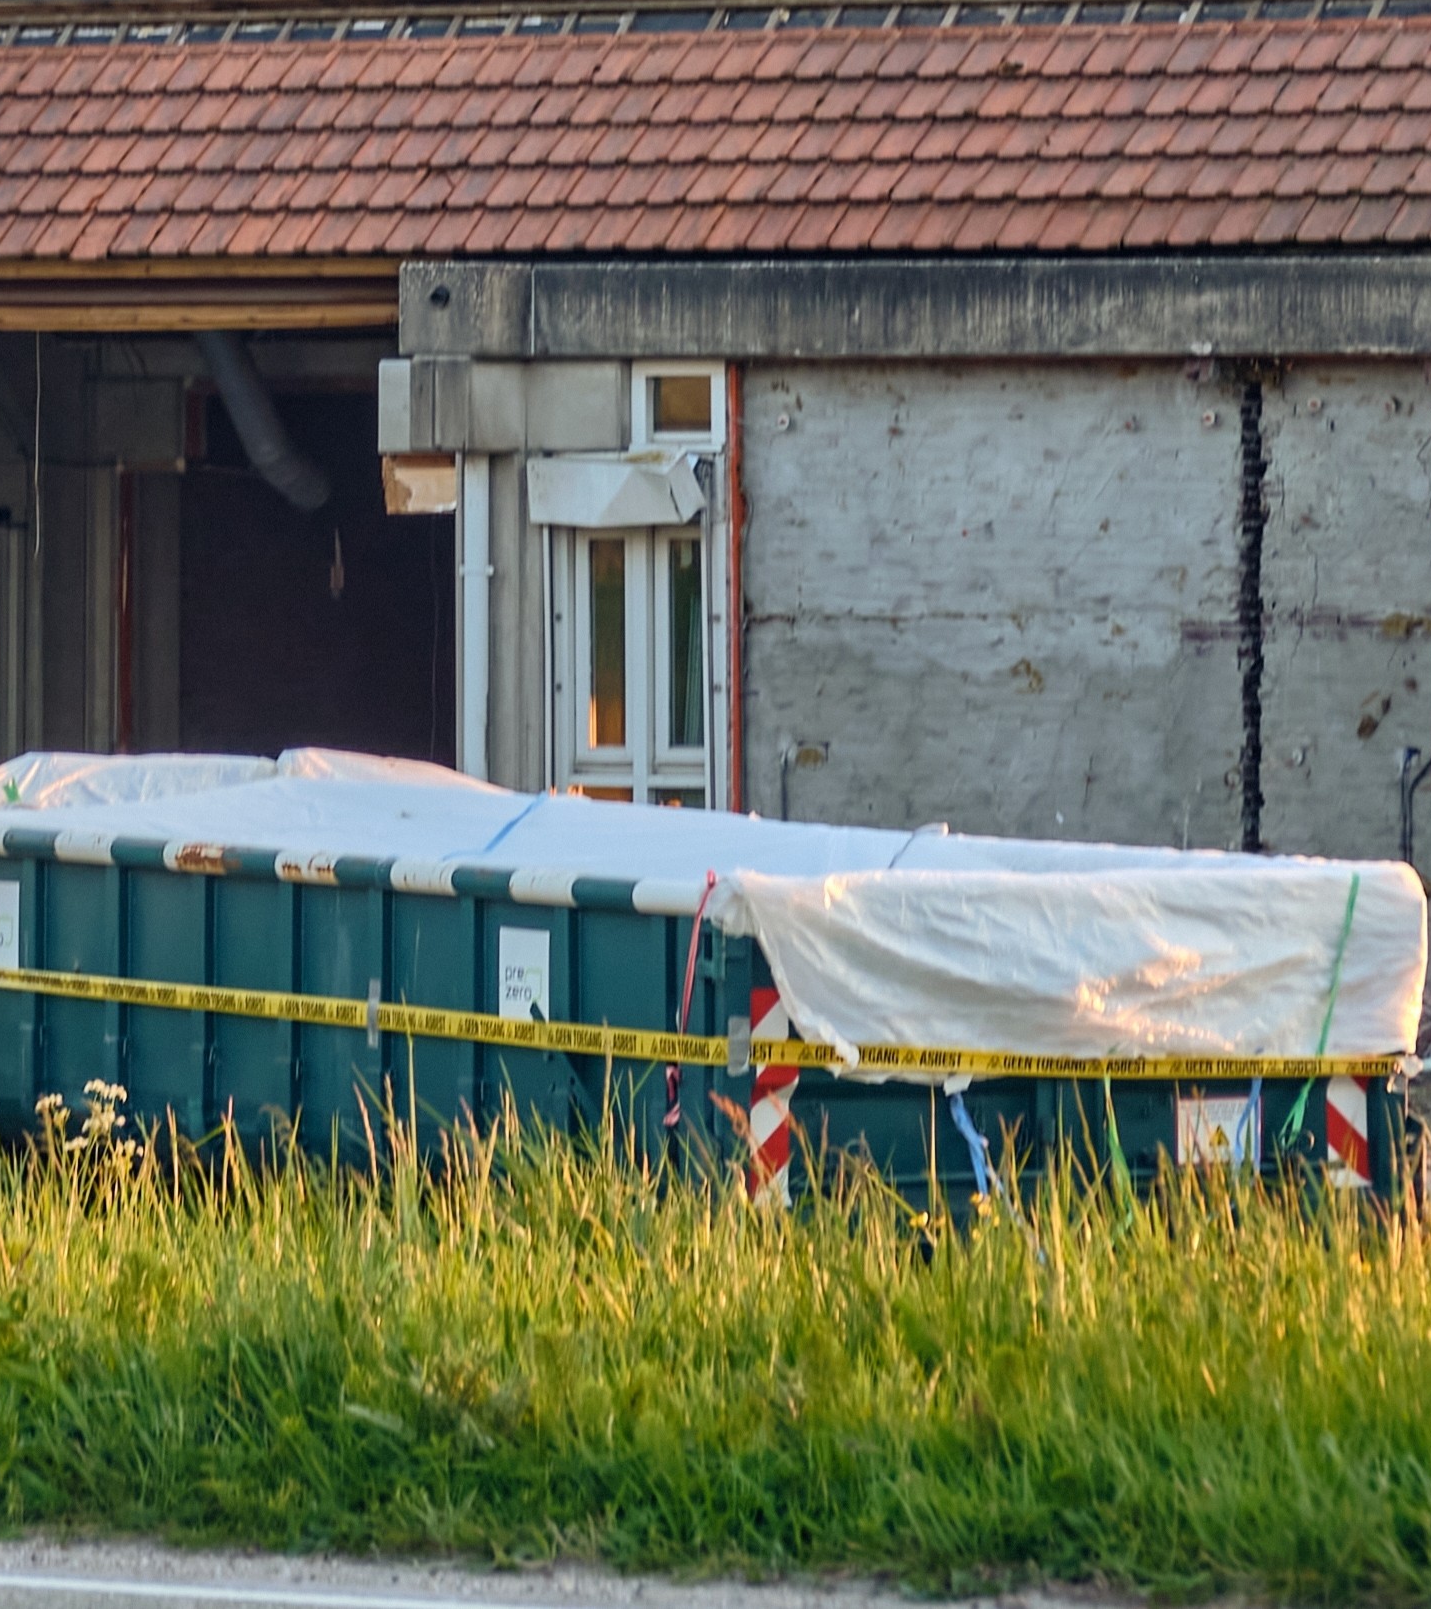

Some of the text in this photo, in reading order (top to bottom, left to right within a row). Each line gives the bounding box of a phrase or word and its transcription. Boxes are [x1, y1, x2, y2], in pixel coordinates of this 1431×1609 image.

[505, 986, 532, 1002] zero
[919, 1048, 962, 1068] ASBEST
[1003, 1055, 1032, 1070] GEEN
[1036, 1056, 1087, 1072] TOEGANG
